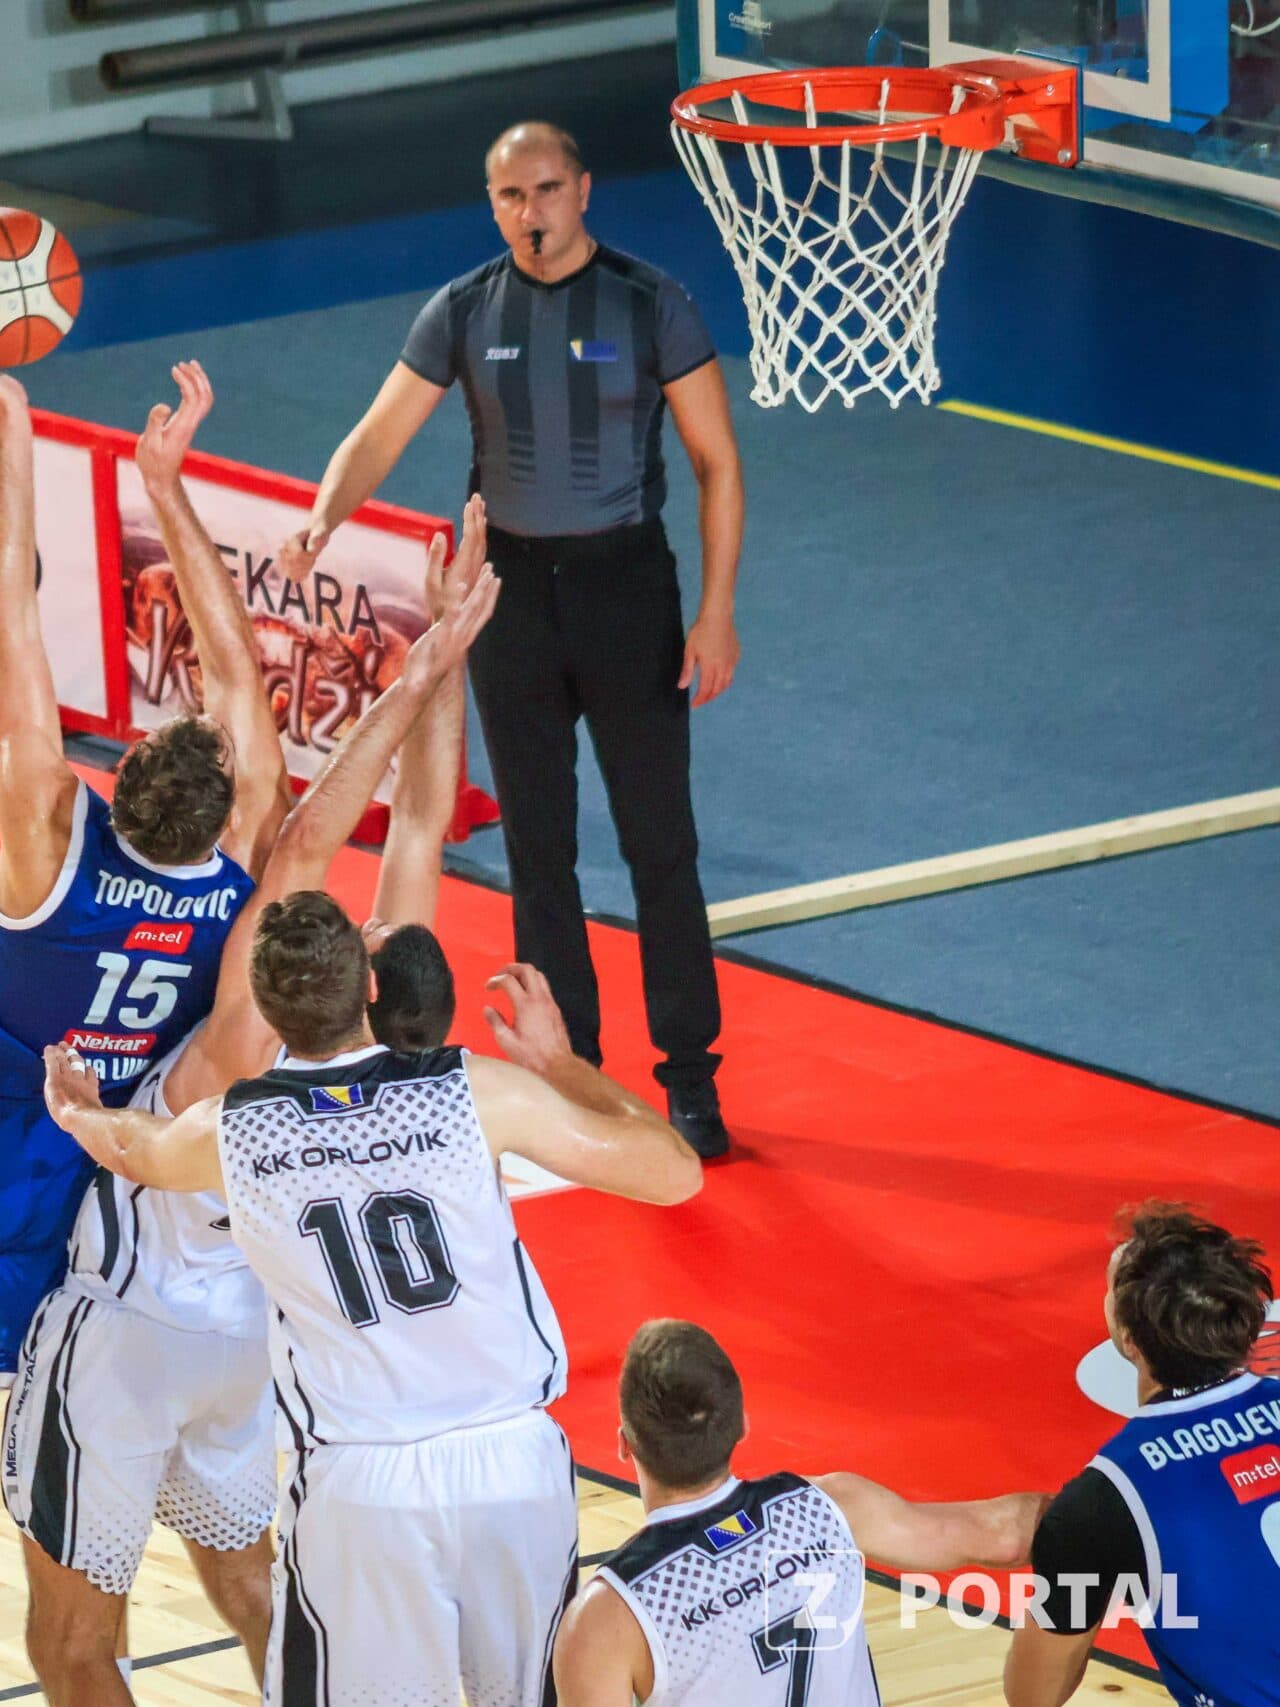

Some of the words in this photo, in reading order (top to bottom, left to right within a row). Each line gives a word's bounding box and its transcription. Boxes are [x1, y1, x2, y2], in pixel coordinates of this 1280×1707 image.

[83, 951, 193, 1029] 15
[71, 1034, 148, 1051] Nektar
[252, 1151, 296, 1179] KK
[300, 1129, 449, 1168] ORLOVIK
[297, 1188, 462, 1329] 10
[1139, 1397, 1280, 1472] BLAGOJEV
[680, 1597, 723, 1632] KK
[723, 1539, 836, 1609] ORLOVIK
[750, 1605, 818, 1707] 7
